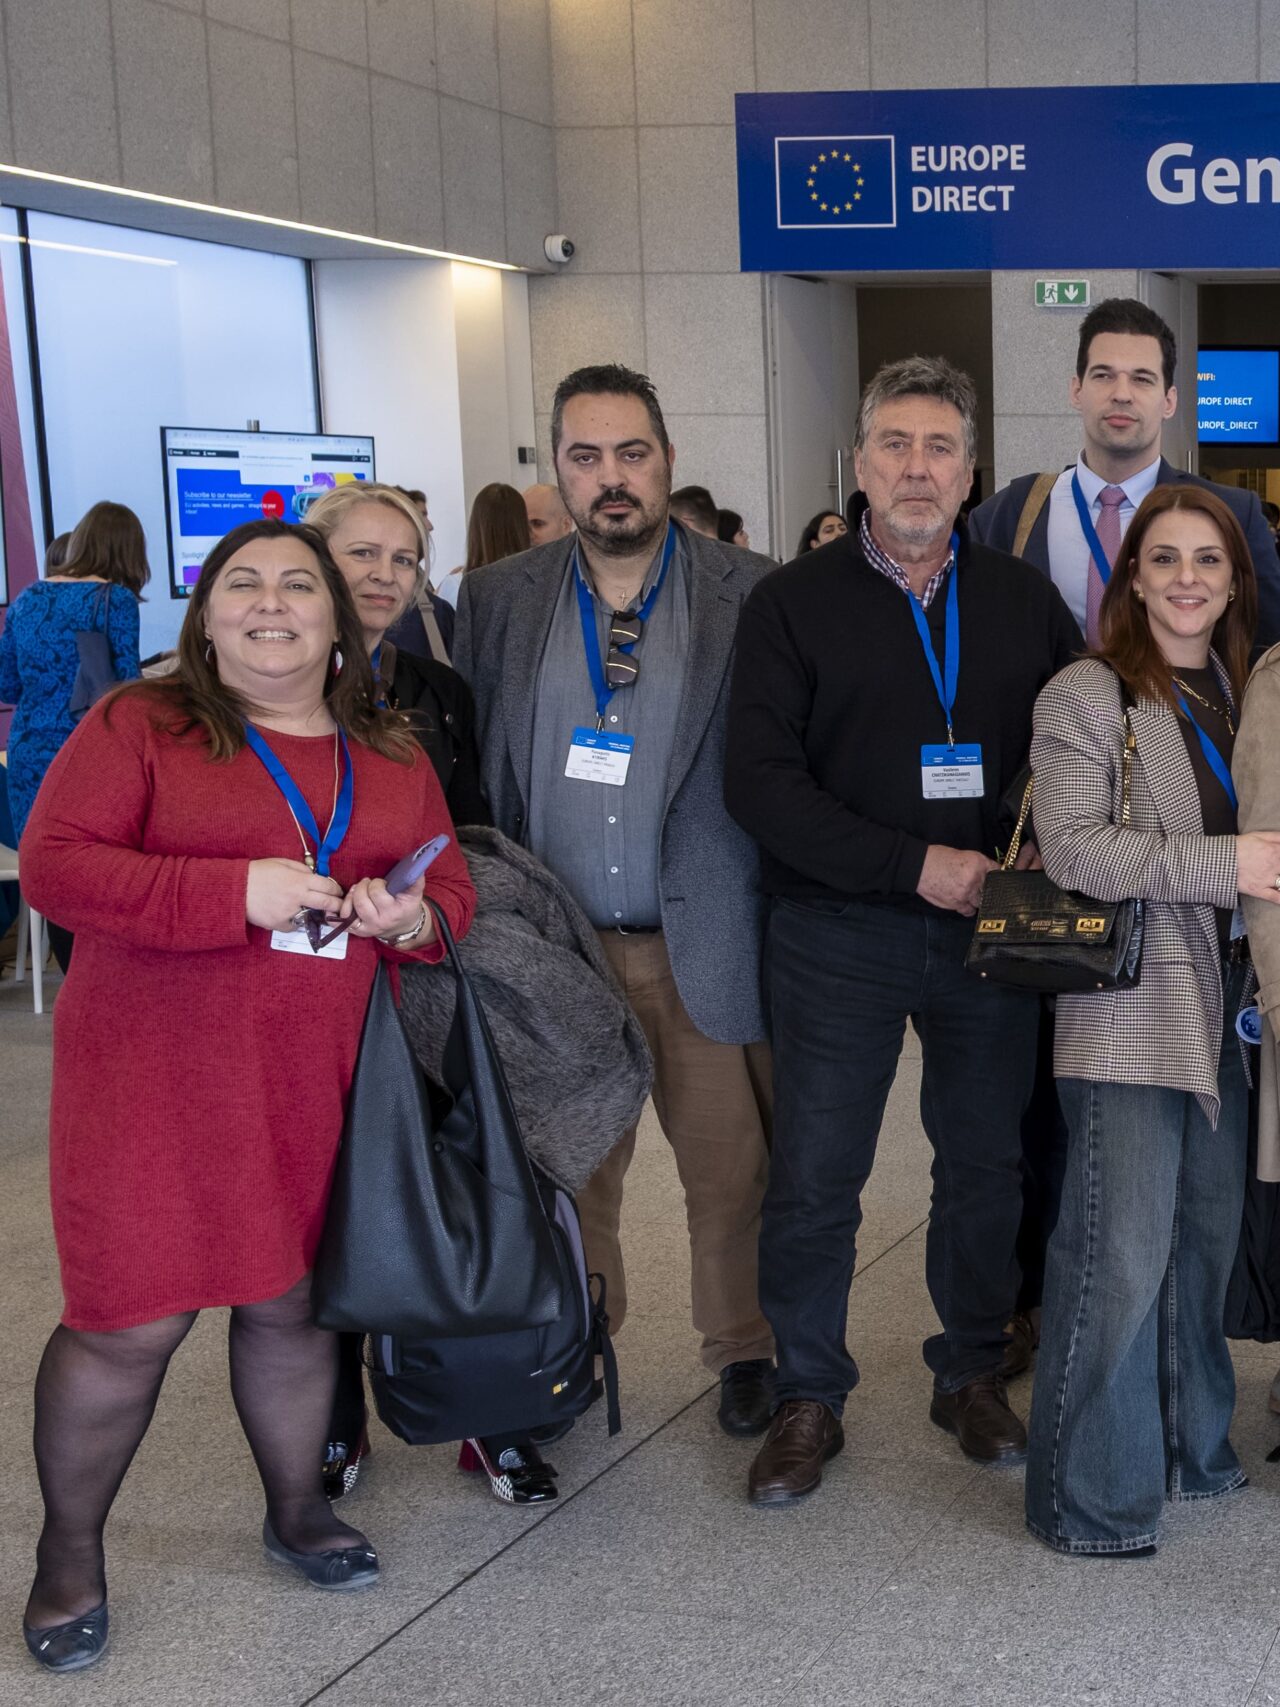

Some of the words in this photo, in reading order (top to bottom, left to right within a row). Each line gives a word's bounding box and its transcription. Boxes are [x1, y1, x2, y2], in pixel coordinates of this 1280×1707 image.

[910, 143, 1027, 173] EUROPE
[911, 184, 1015, 214] DIRECT
[1197, 397, 1222, 406] UROPE
[1224, 397, 1253, 406] DIRECT
[1198, 421, 1258, 431] UROPE_DIRECT
